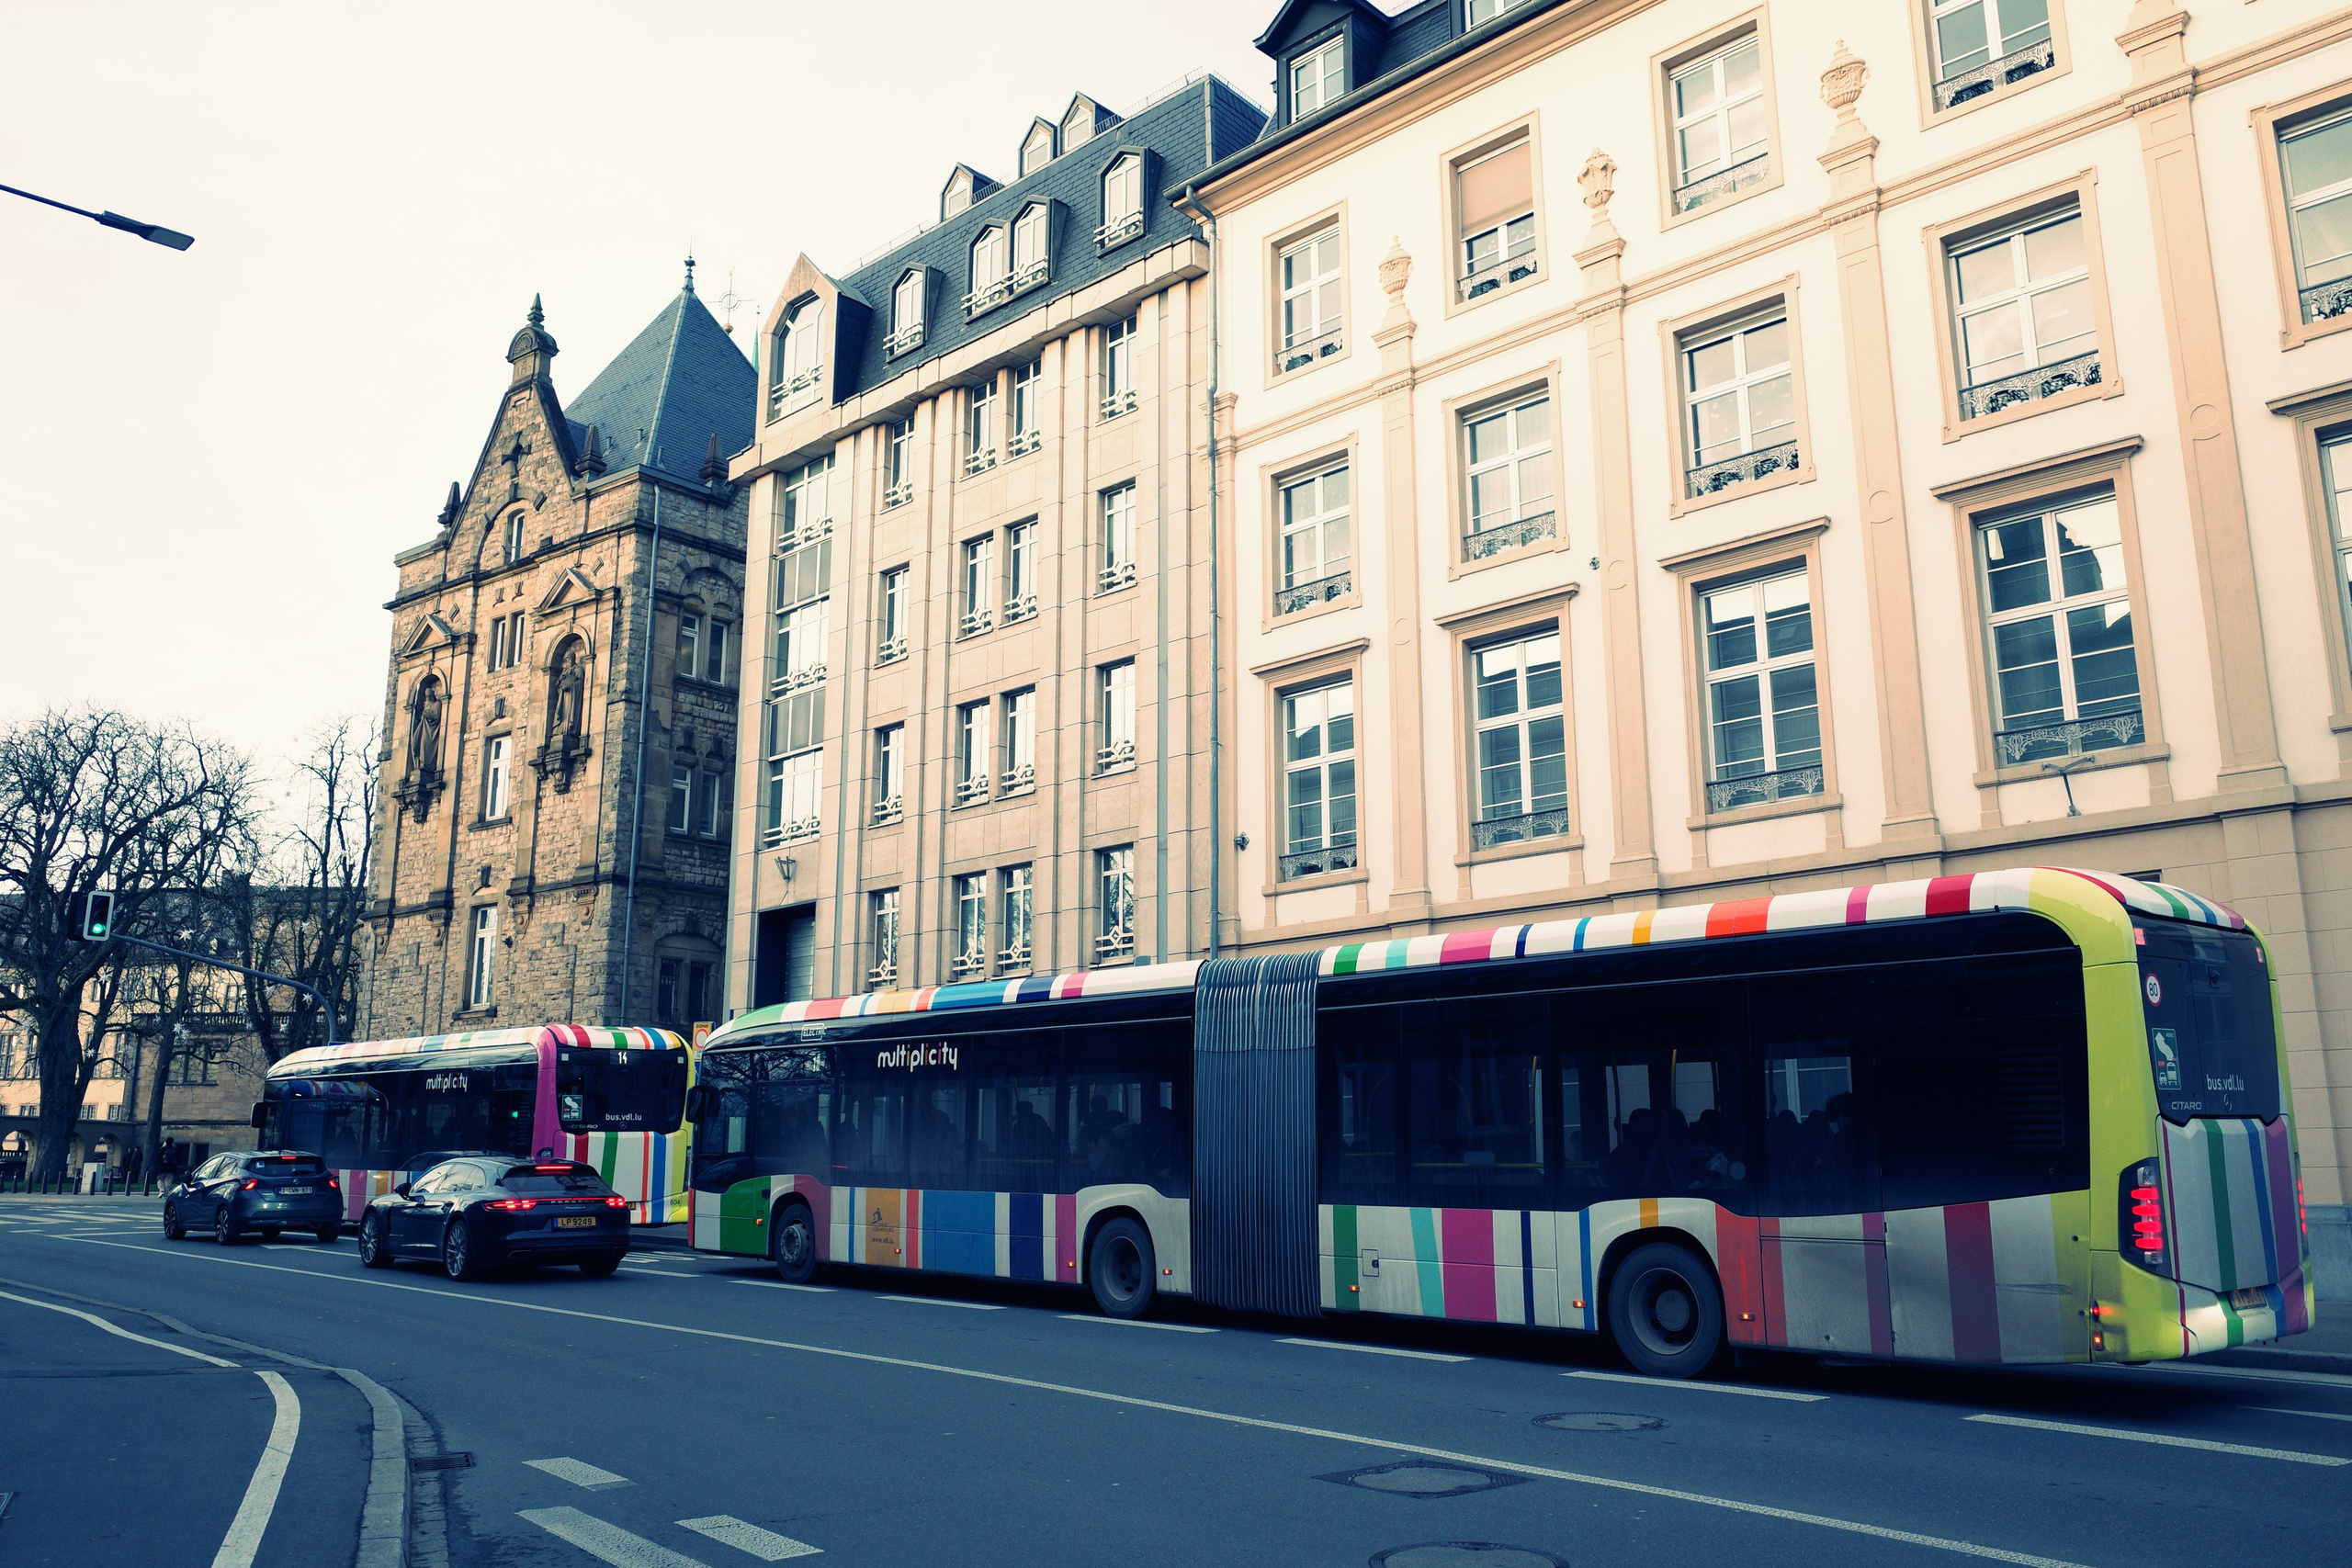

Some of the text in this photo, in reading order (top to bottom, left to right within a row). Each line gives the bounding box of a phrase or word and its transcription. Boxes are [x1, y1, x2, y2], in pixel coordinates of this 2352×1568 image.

[2148, 983, 2158, 997] 80
[617, 1051, 628, 1064] 14
[877, 1041, 957, 1073] multiplicity
[425, 1072, 468, 1093] multiplicity
[2206, 1074, 2245, 1091] bus.vdl.lu
[561, 1217, 593, 1226] LP 9249
